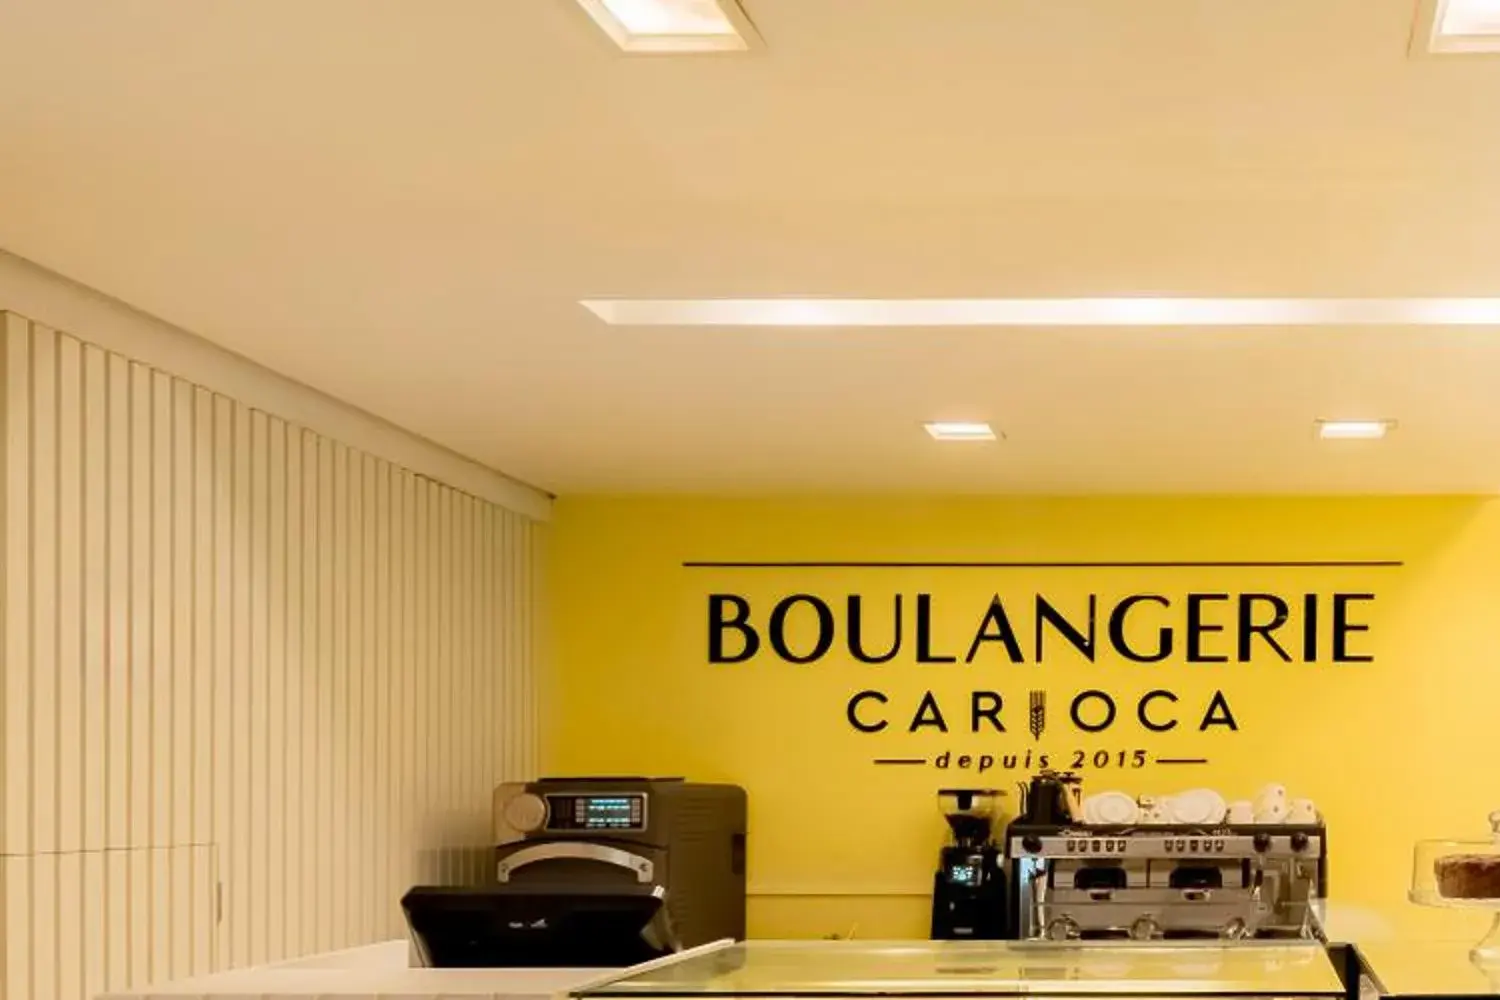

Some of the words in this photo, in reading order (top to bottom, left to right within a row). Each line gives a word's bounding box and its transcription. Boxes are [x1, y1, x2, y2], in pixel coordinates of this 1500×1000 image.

[707, 593, 1376, 665] BOULANGERIE
[845, 689, 1239, 738] CARIOCA
[934, 749, 1050, 771] depuis
[1071, 749, 1147, 769] 2015
